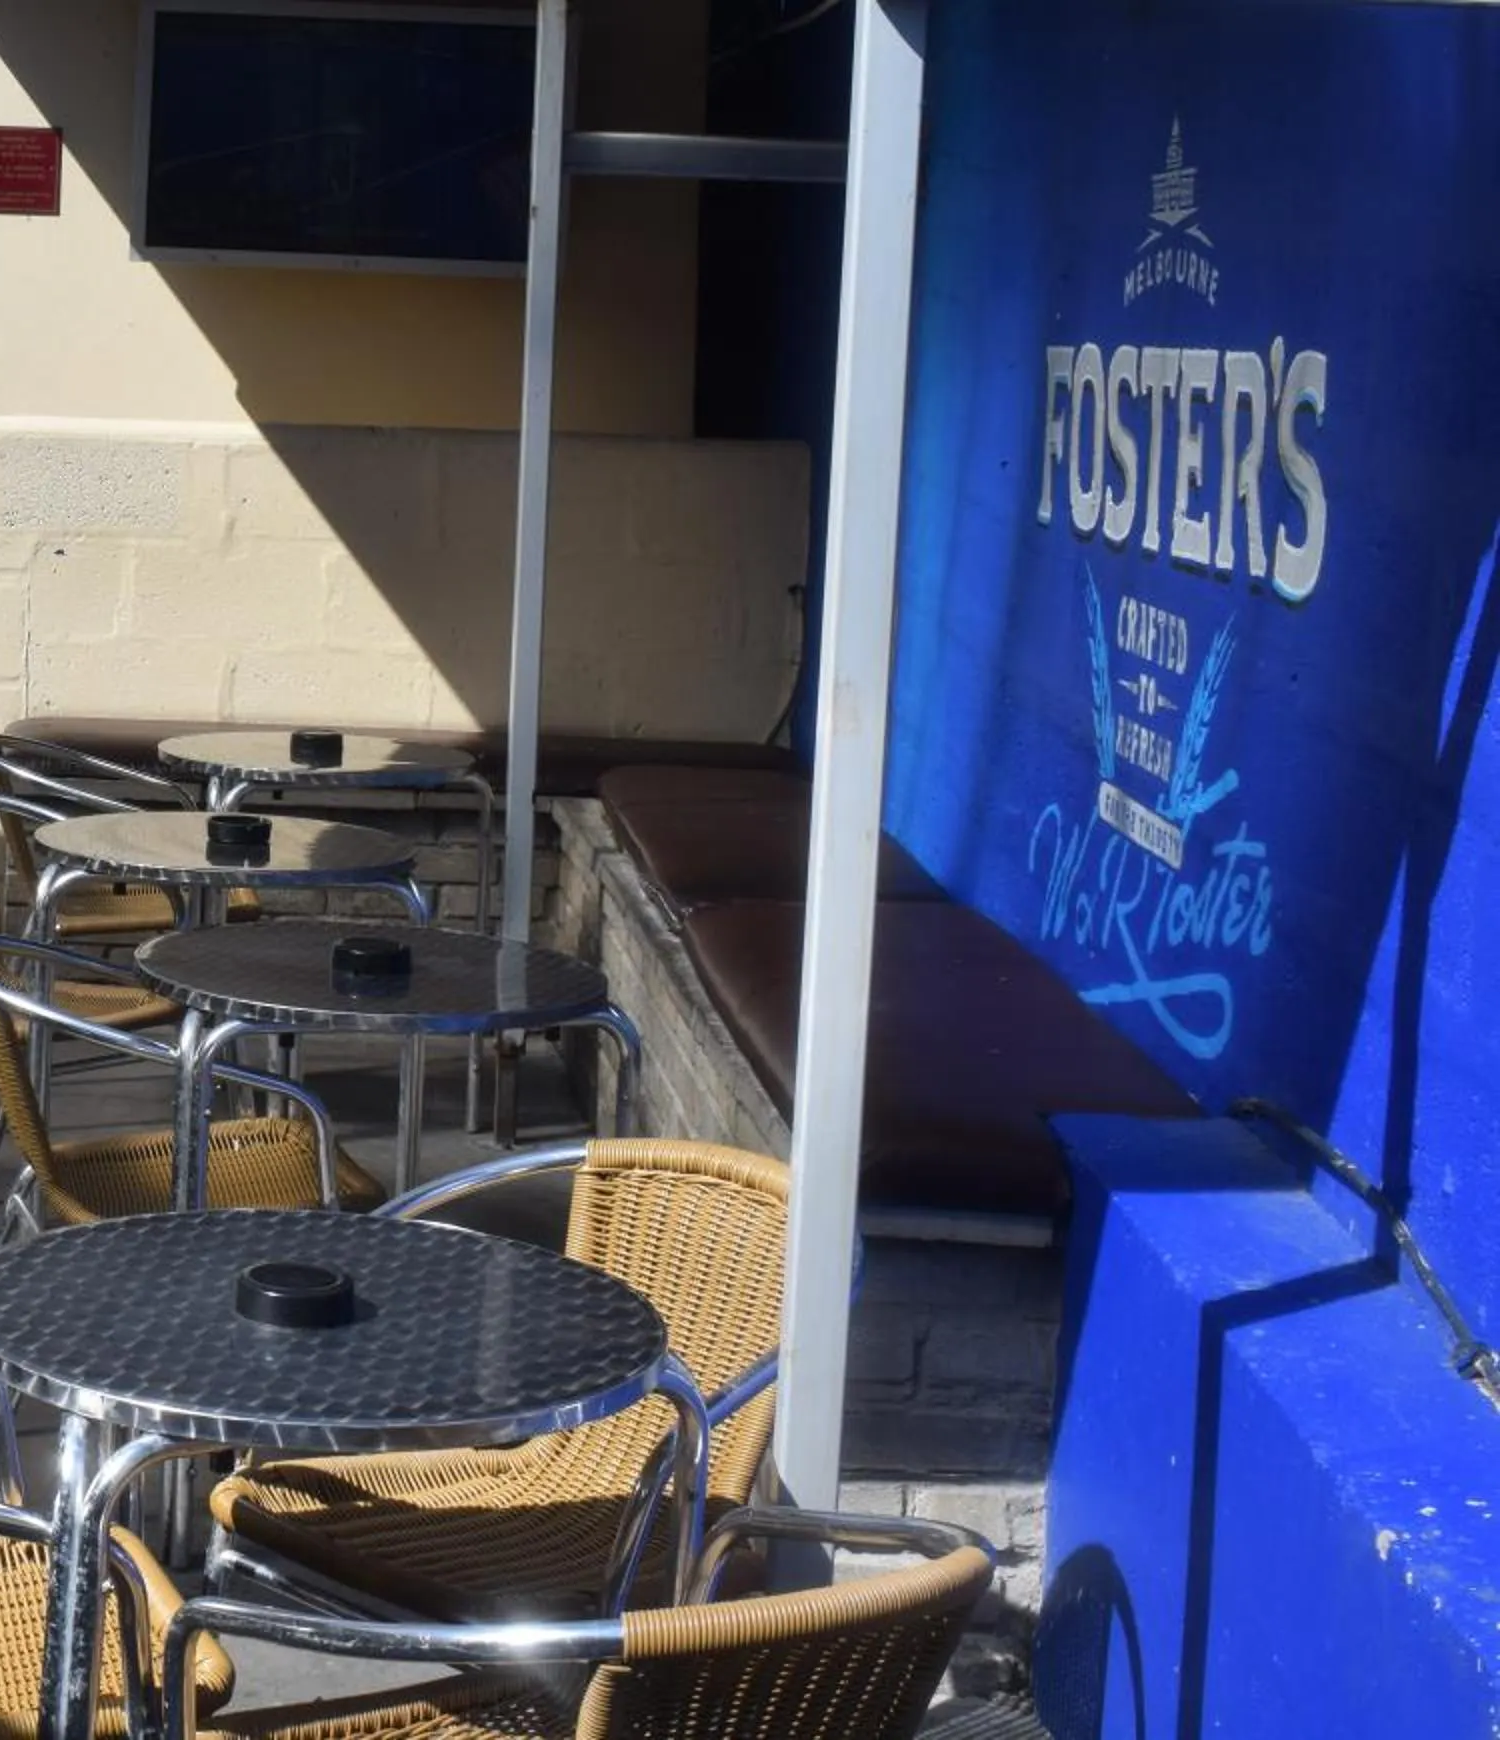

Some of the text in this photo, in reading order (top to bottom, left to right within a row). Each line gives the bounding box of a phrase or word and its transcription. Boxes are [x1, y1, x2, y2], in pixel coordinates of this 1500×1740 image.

[1123, 247, 1219, 308] MELBOURNE
[1036, 335, 1329, 603] FOSTER'S
[1117, 595, 1188, 676] CRAFTED
[1138, 673, 1156, 717] TO
